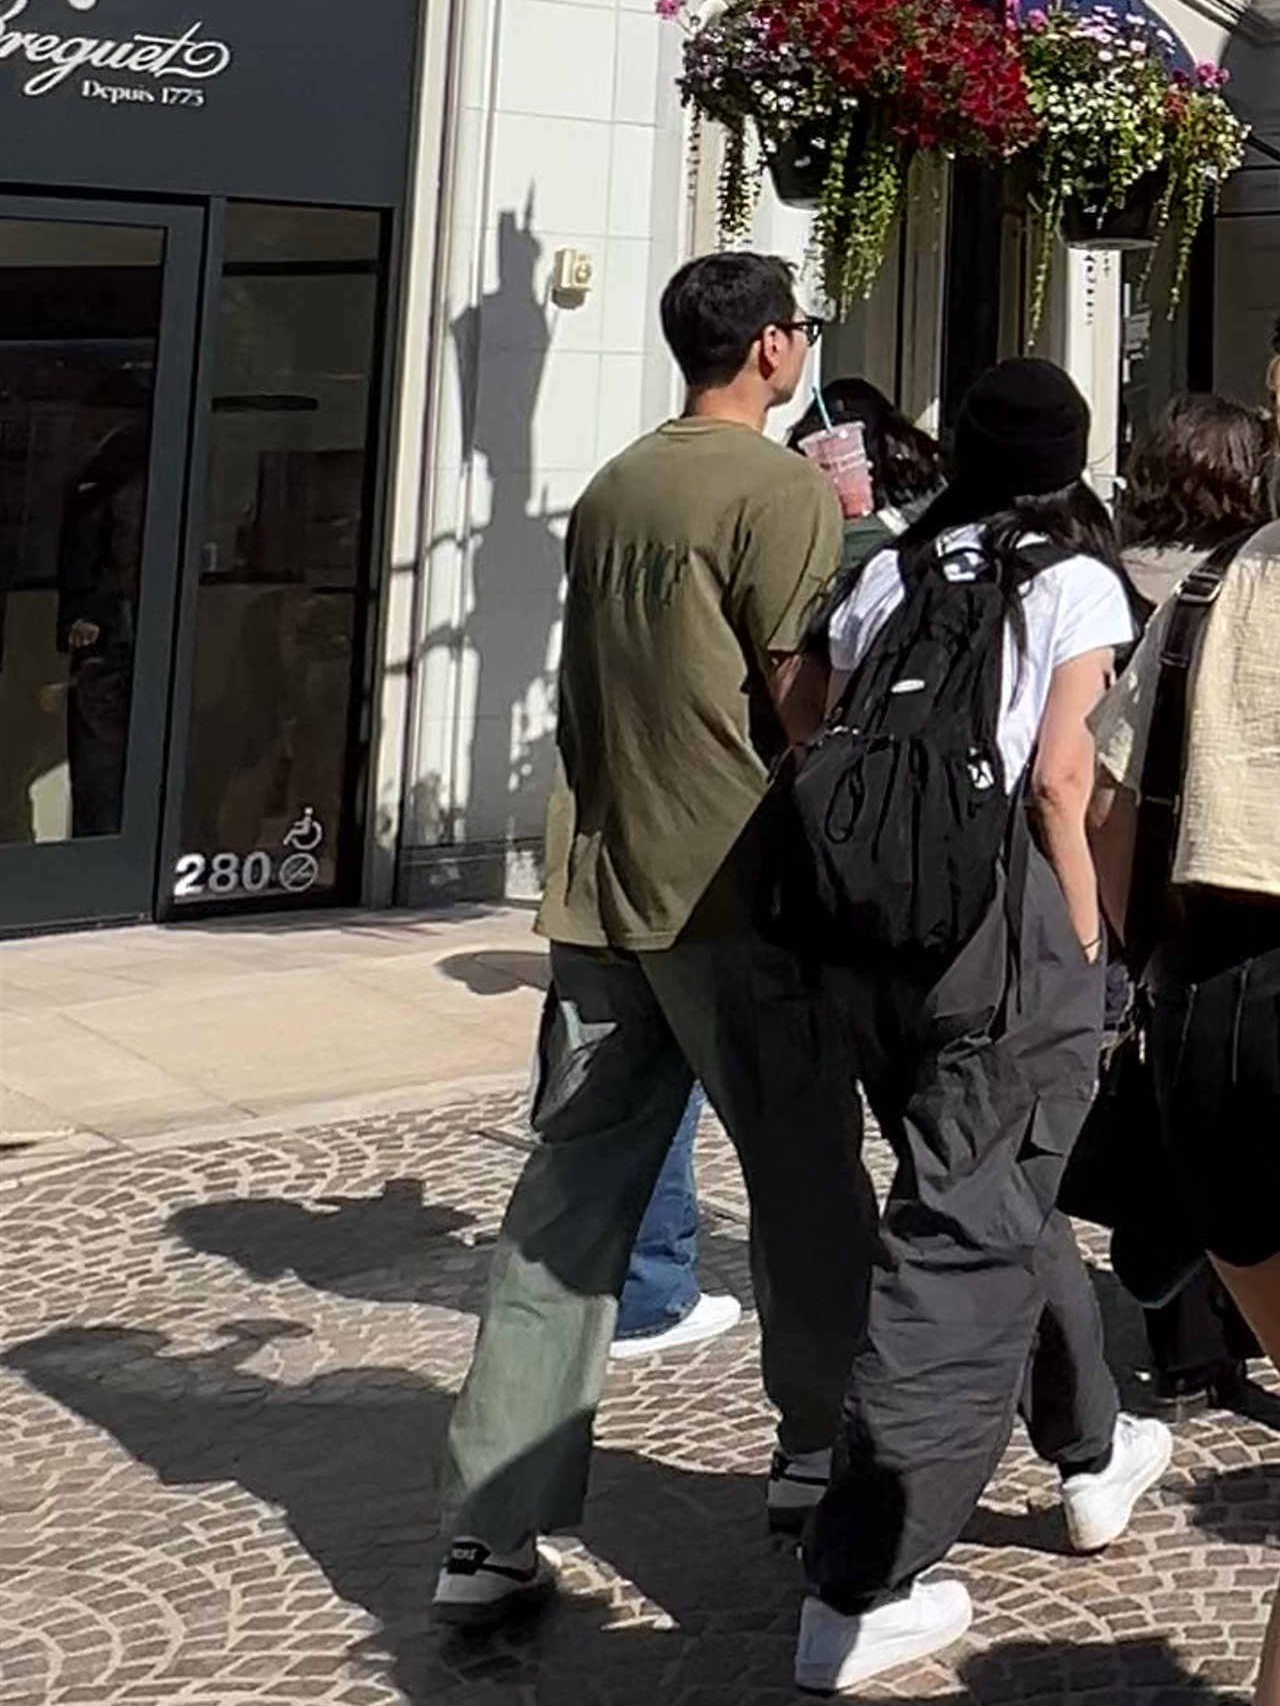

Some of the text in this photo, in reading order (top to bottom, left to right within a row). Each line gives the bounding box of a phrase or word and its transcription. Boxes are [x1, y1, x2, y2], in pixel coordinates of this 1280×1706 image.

[82, 80, 204, 106] Depuis 1775
[174, 851, 271, 896] 280
